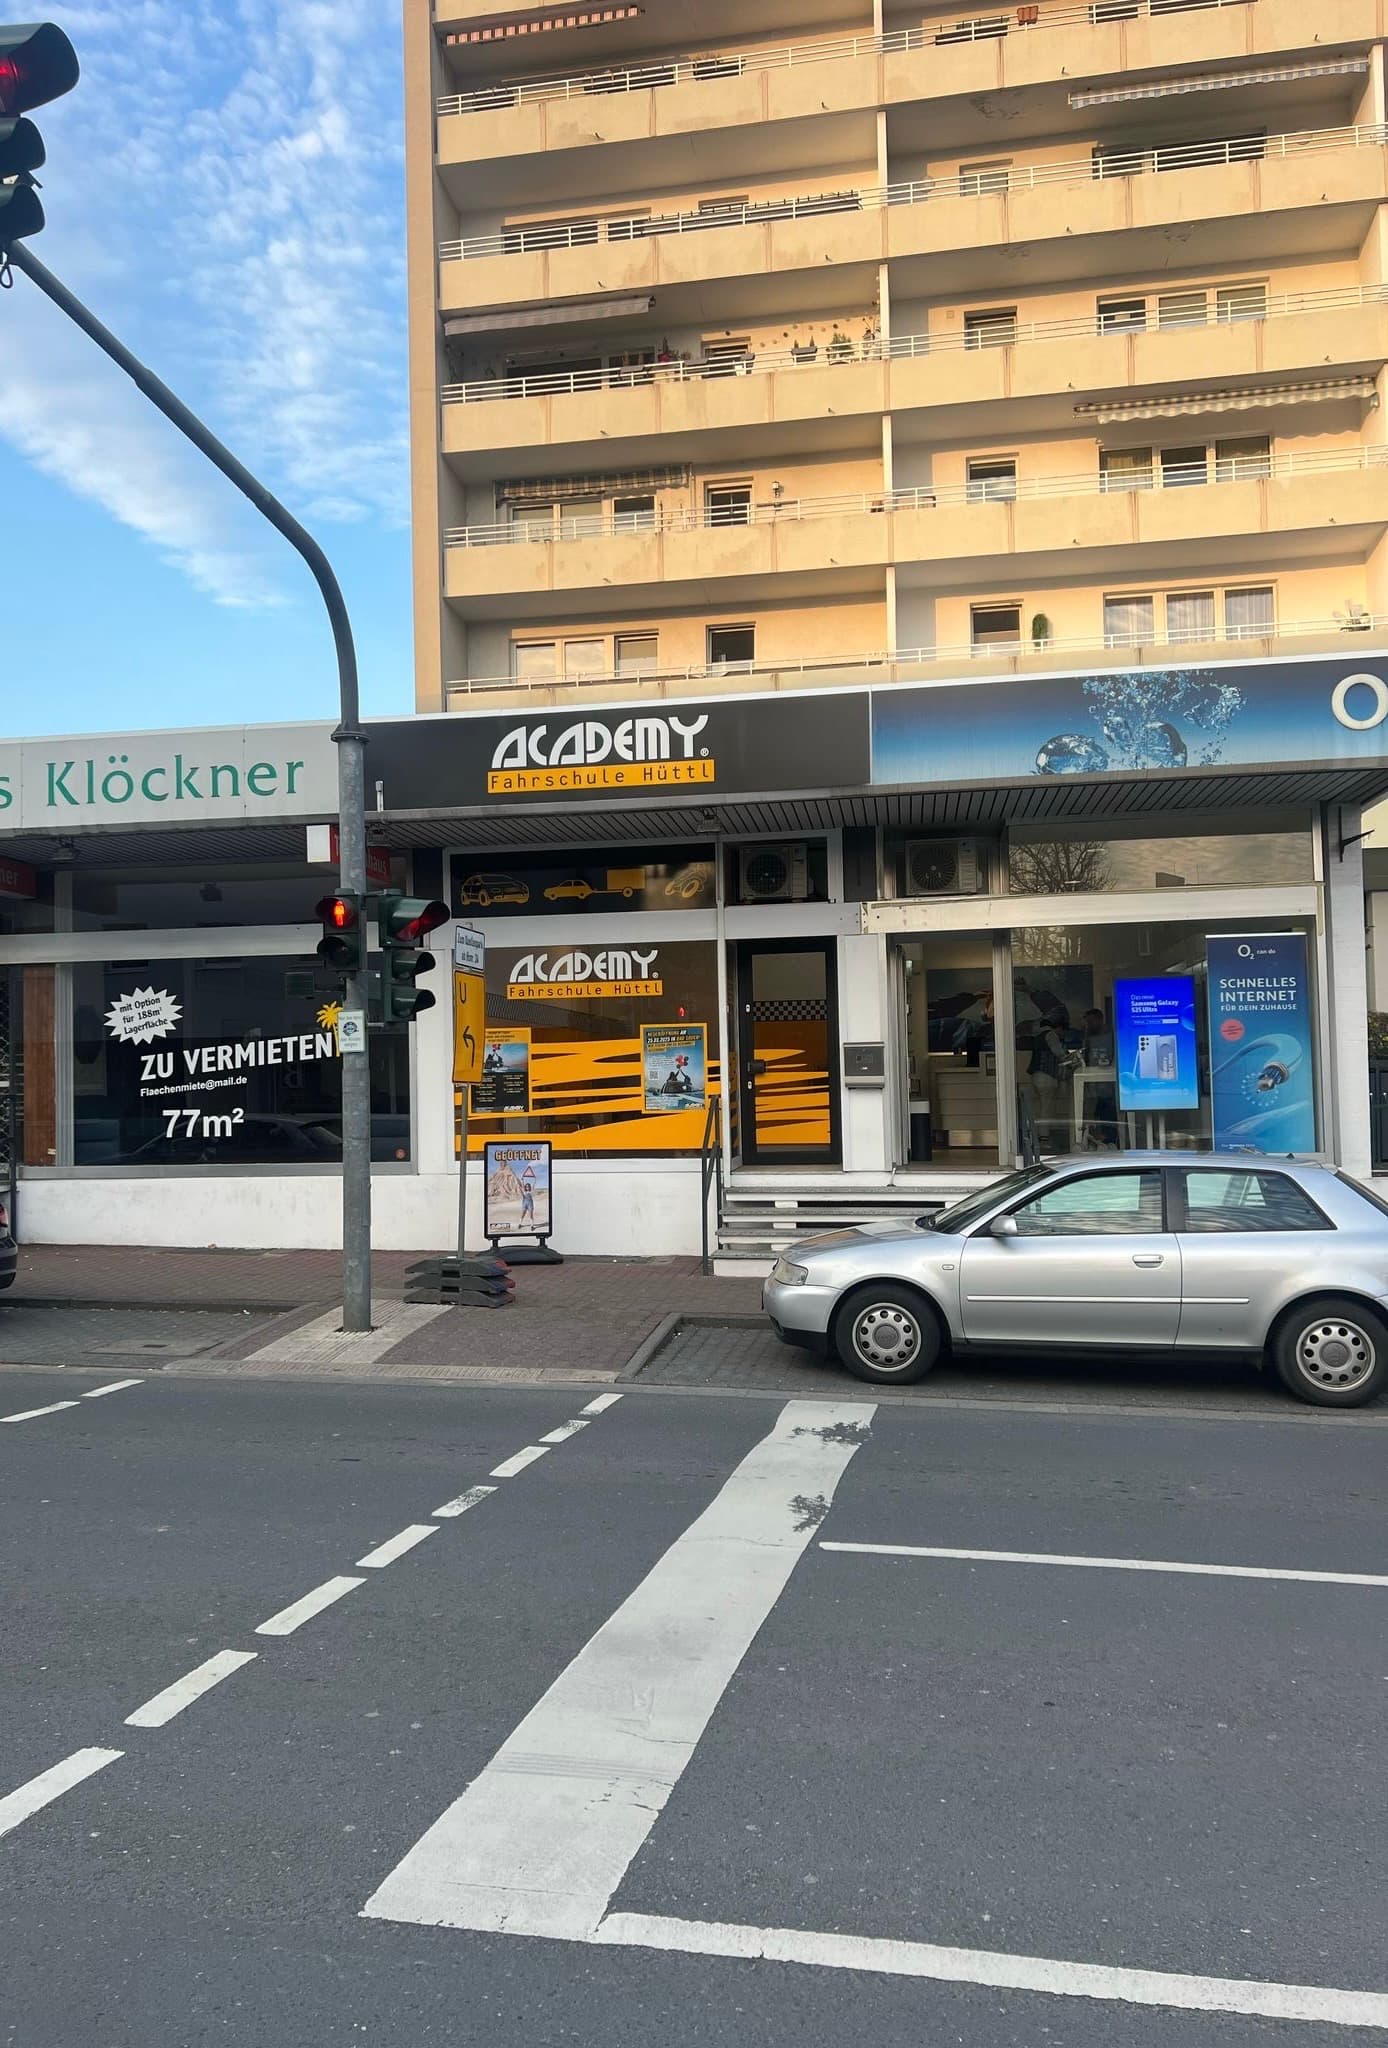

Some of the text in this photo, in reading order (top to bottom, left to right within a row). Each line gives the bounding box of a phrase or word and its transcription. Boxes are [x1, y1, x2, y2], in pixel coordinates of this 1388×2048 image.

[47, 753, 305, 807] Klöckner
[491, 763, 709, 789] Fahrschule Hüttl
[510, 981, 660, 997] Fahrschule Hüttl
[1219, 977, 1297, 988] SCHNELLES
[1220, 990, 1297, 1002] INTERNET
[120, 997, 161, 1013] mit Option
[1220, 1003, 1236, 1012] FÜR
[140, 1032, 333, 1081] ZU VERMIETEN
[140, 1076, 248, 1097] Flaechenmiete@mail.de
[495, 1149, 541, 1161] GEÖFFNET
